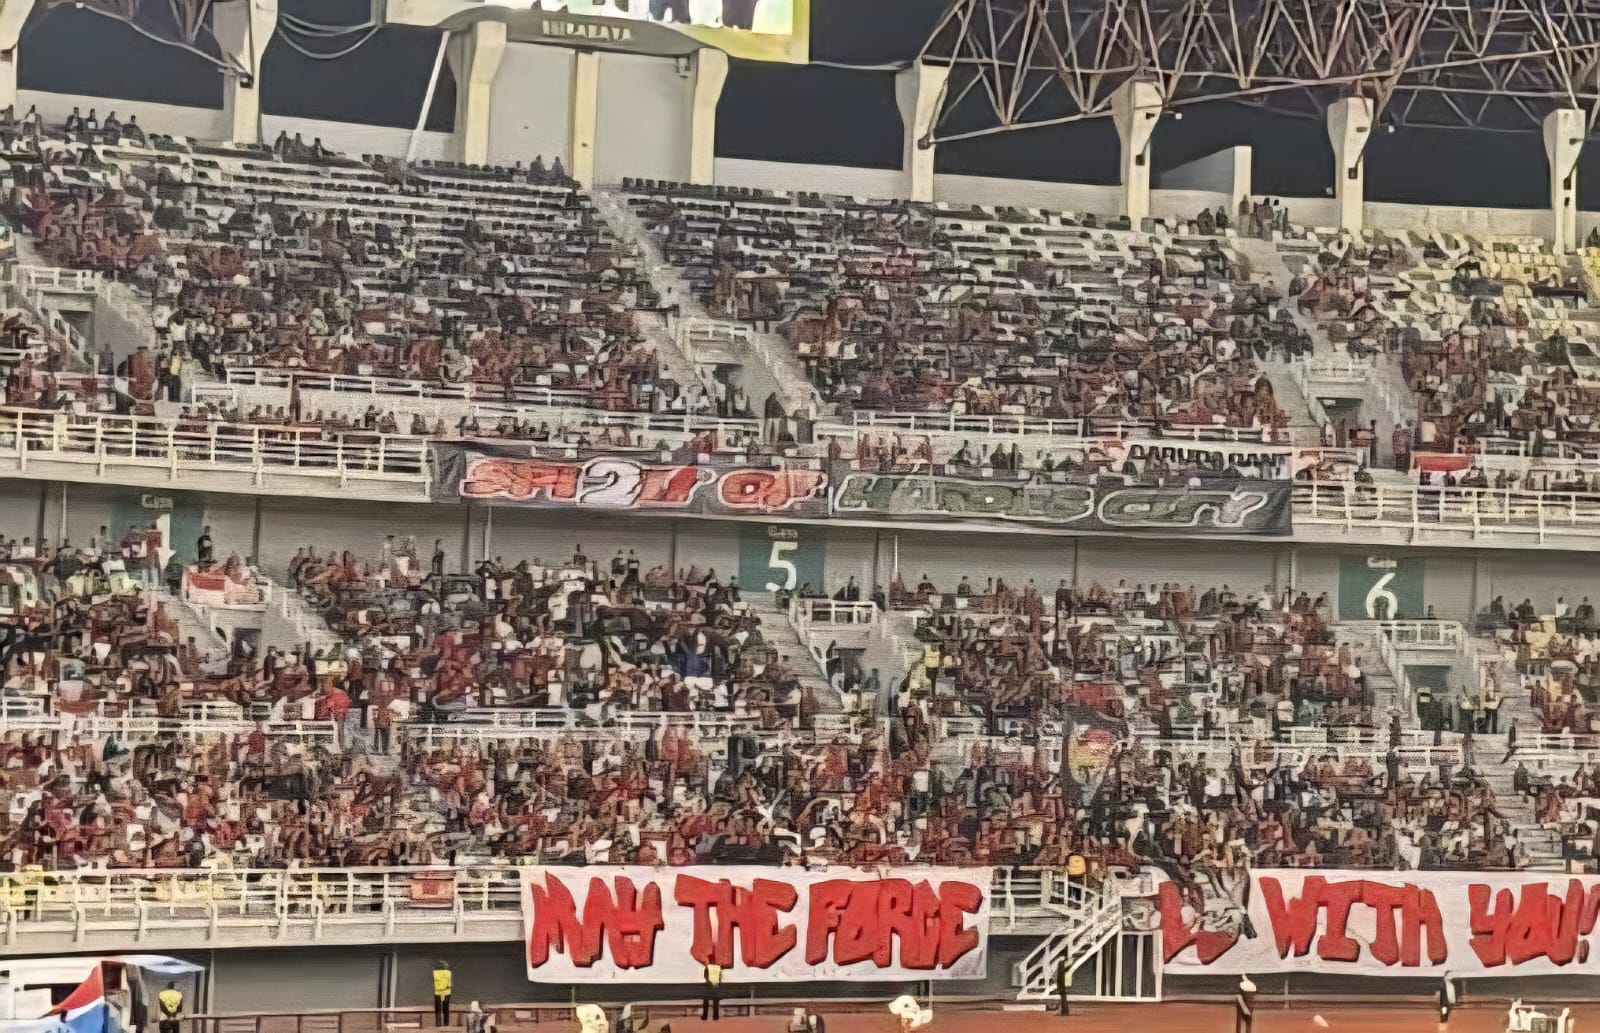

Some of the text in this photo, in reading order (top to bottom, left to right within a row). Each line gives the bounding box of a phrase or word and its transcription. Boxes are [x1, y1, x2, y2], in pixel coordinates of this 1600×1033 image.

[765, 541, 799, 592] 5
[1365, 572, 1398, 620] 6
[674, 873, 799, 969] THE
[1259, 875, 1448, 967] WITH
